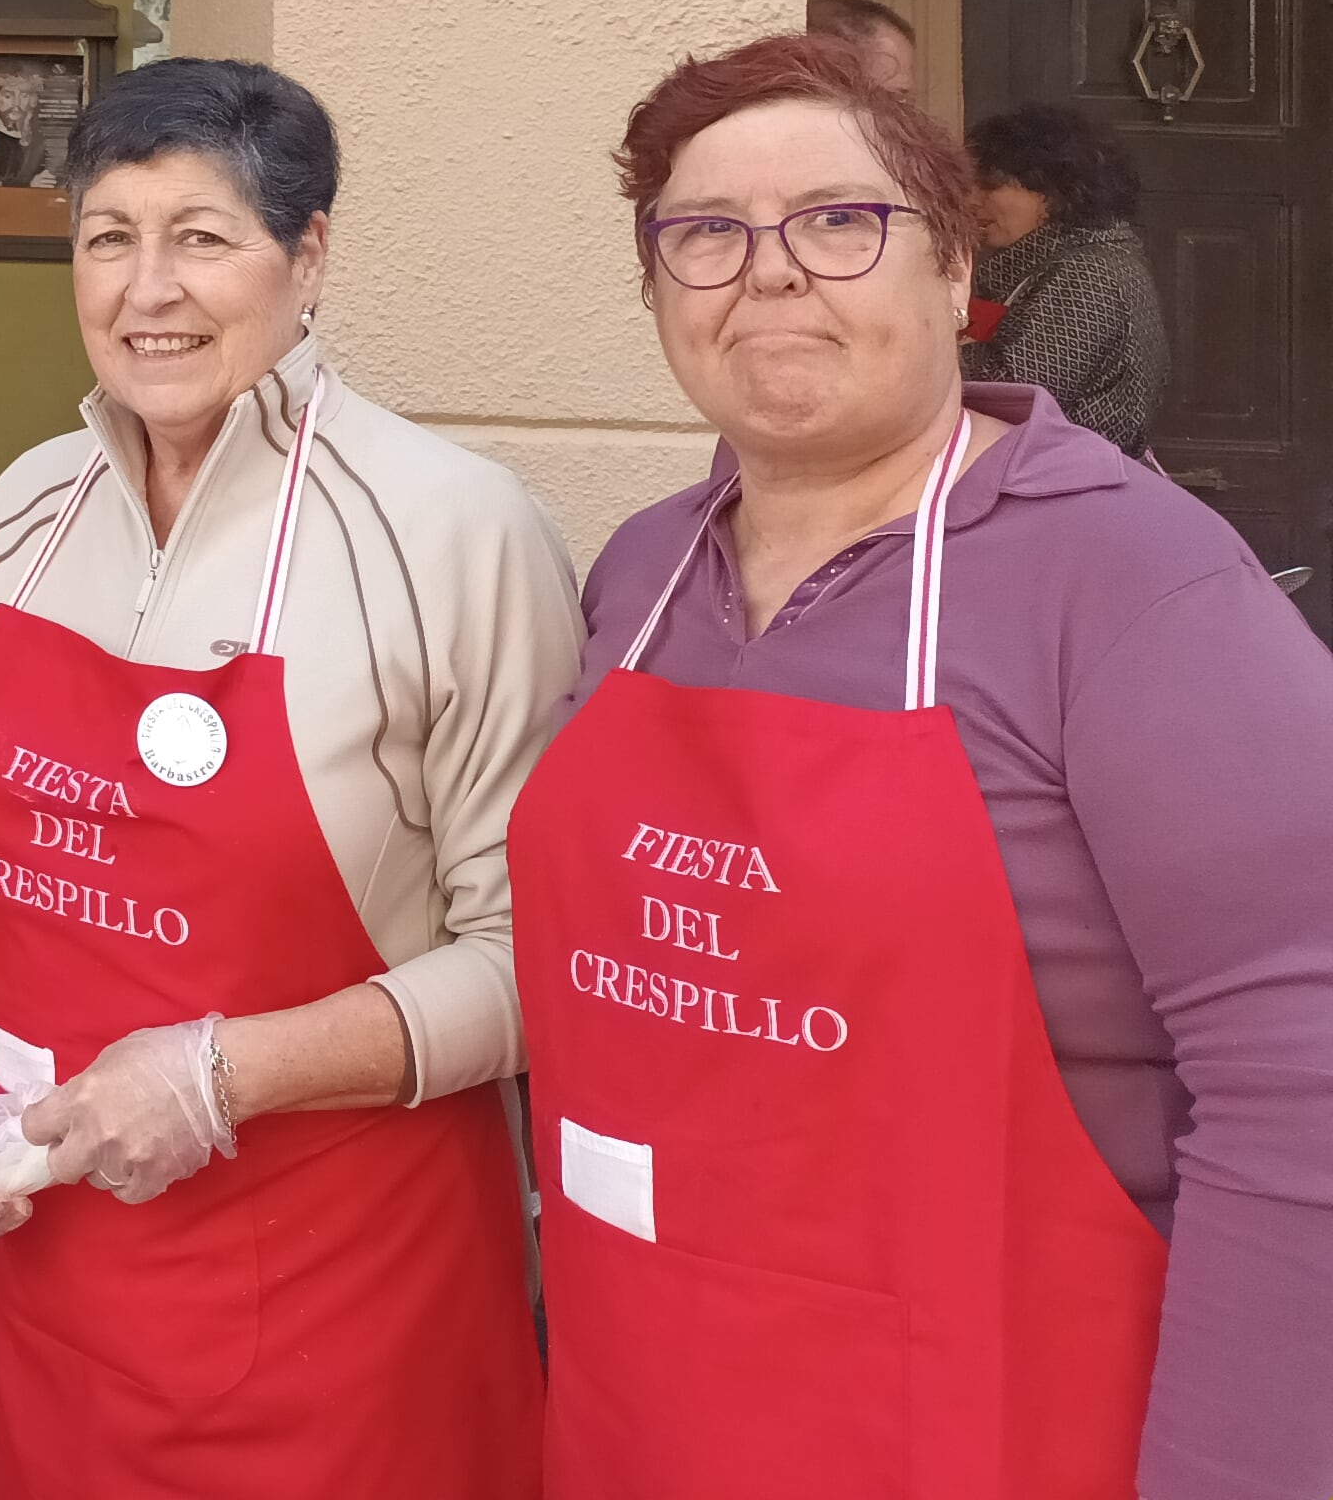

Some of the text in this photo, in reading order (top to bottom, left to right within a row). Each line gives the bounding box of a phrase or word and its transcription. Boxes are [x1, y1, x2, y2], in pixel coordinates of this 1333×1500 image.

[1, 745, 139, 818] FIESTA
[144, 748, 215, 782] Barbastro
[29, 810, 116, 865] DEL
[621, 822, 781, 893] FIESTA
[641, 895, 741, 961] DEL
[570, 949, 848, 1052] CRESPILLO
